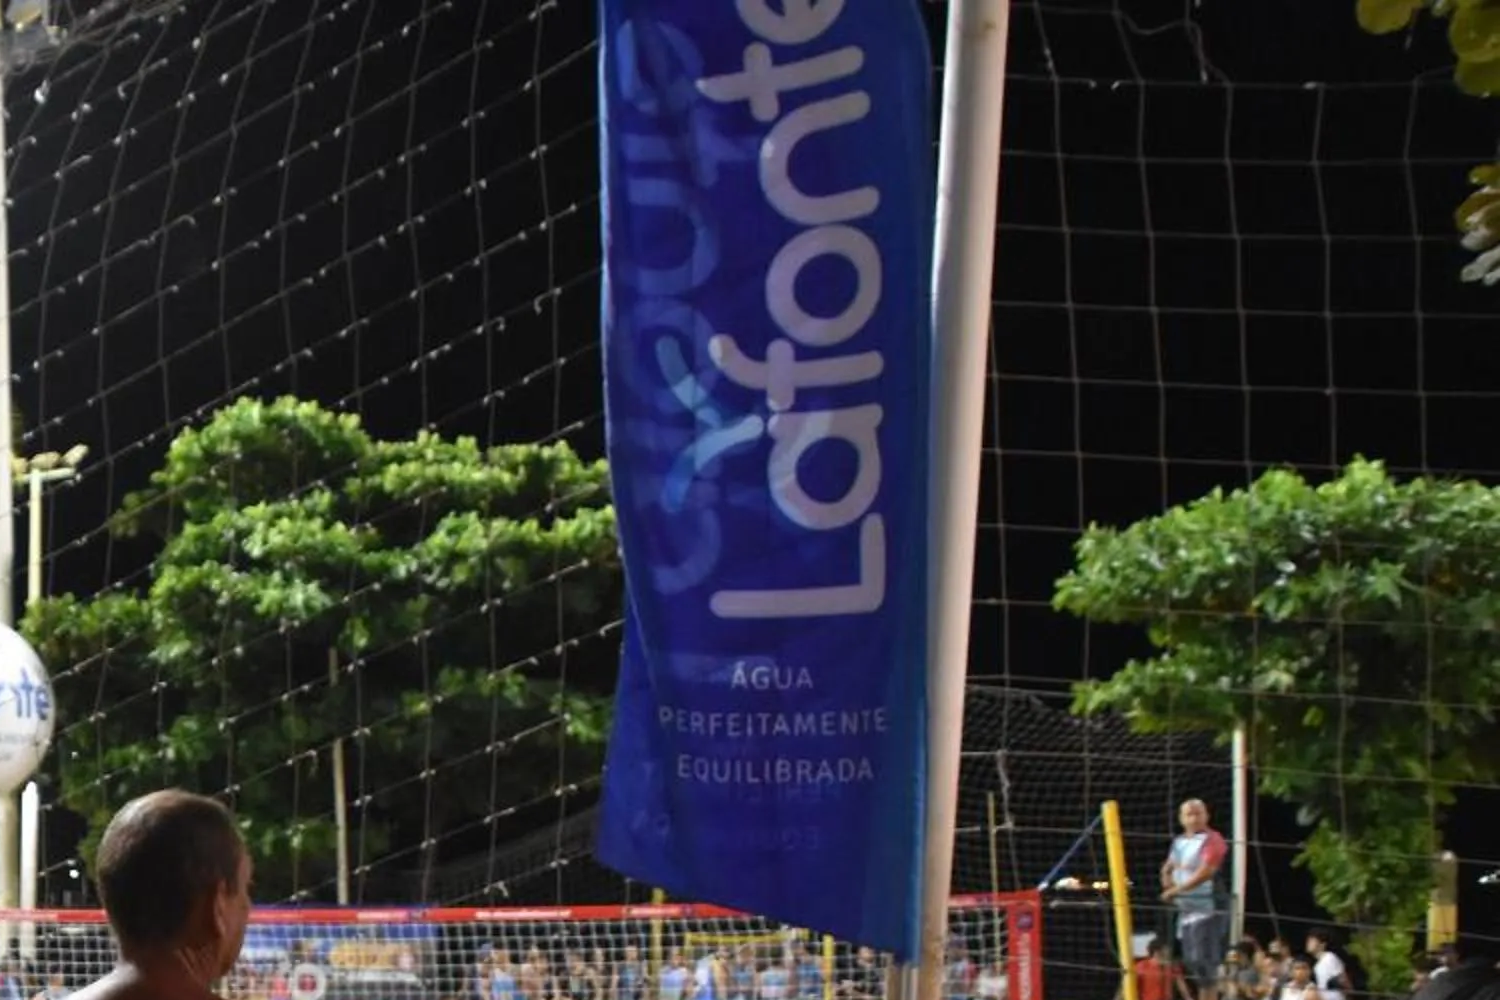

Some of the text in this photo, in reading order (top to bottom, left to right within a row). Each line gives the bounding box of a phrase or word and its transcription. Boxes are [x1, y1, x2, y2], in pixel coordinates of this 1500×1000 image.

[730, 660, 814, 690] ÁGUA
[658, 705, 889, 737] PERFEITAMENTE
[676, 754, 875, 784] EQUILIBRADA
